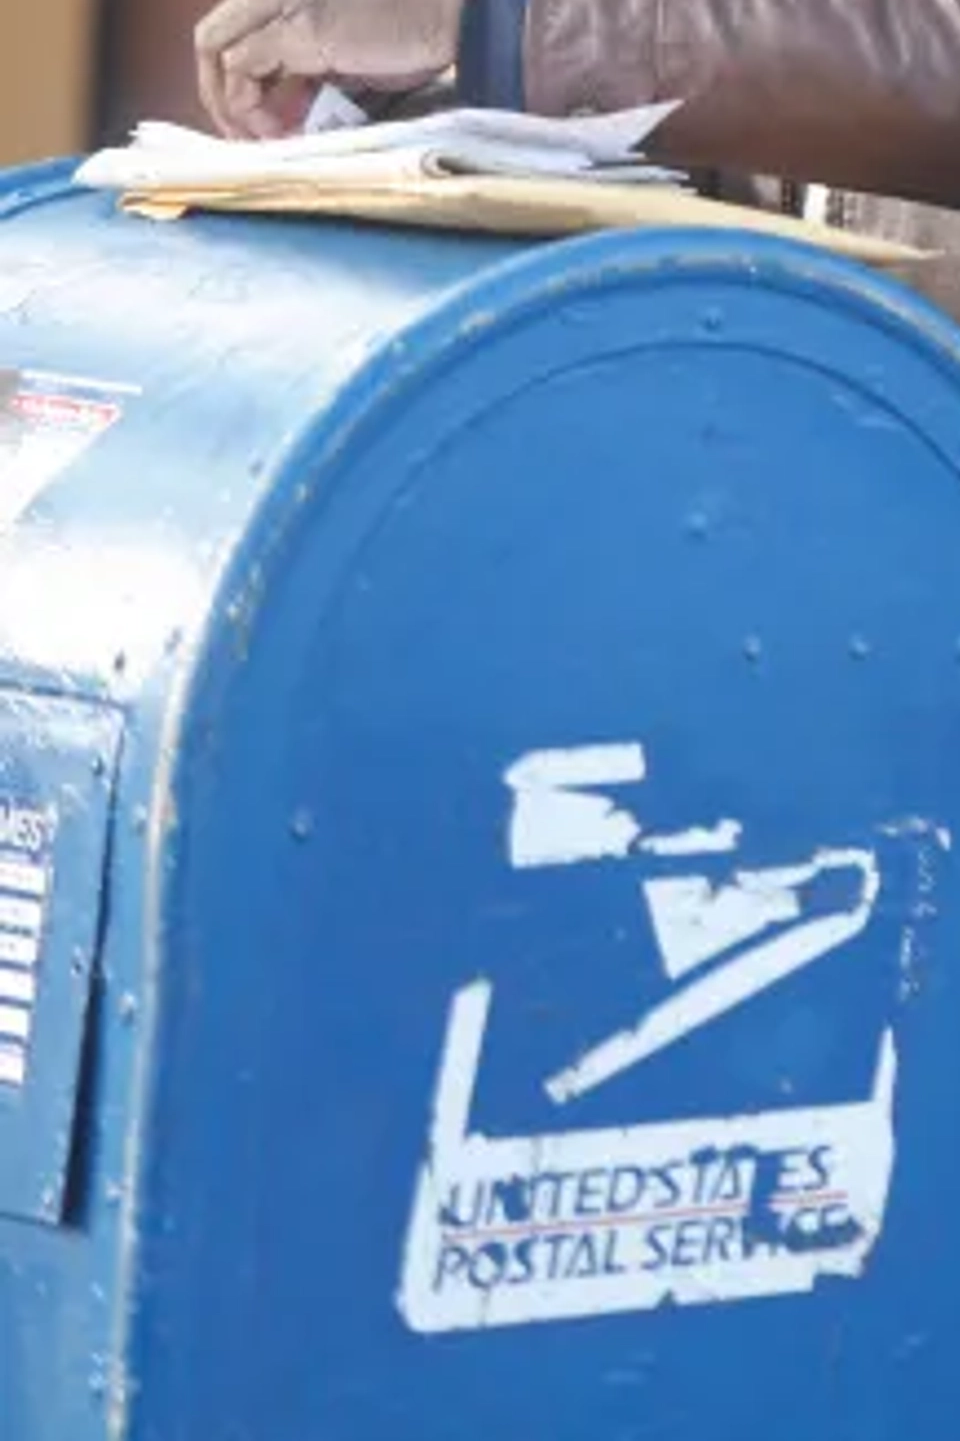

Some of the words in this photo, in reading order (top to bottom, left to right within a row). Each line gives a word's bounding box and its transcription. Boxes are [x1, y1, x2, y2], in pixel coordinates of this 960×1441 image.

[439, 1165, 646, 1226] UNITED
[648, 1143, 831, 1207] STAES
[433, 1229, 625, 1293] POSTAL
[640, 1202, 857, 1270] SERVCE
